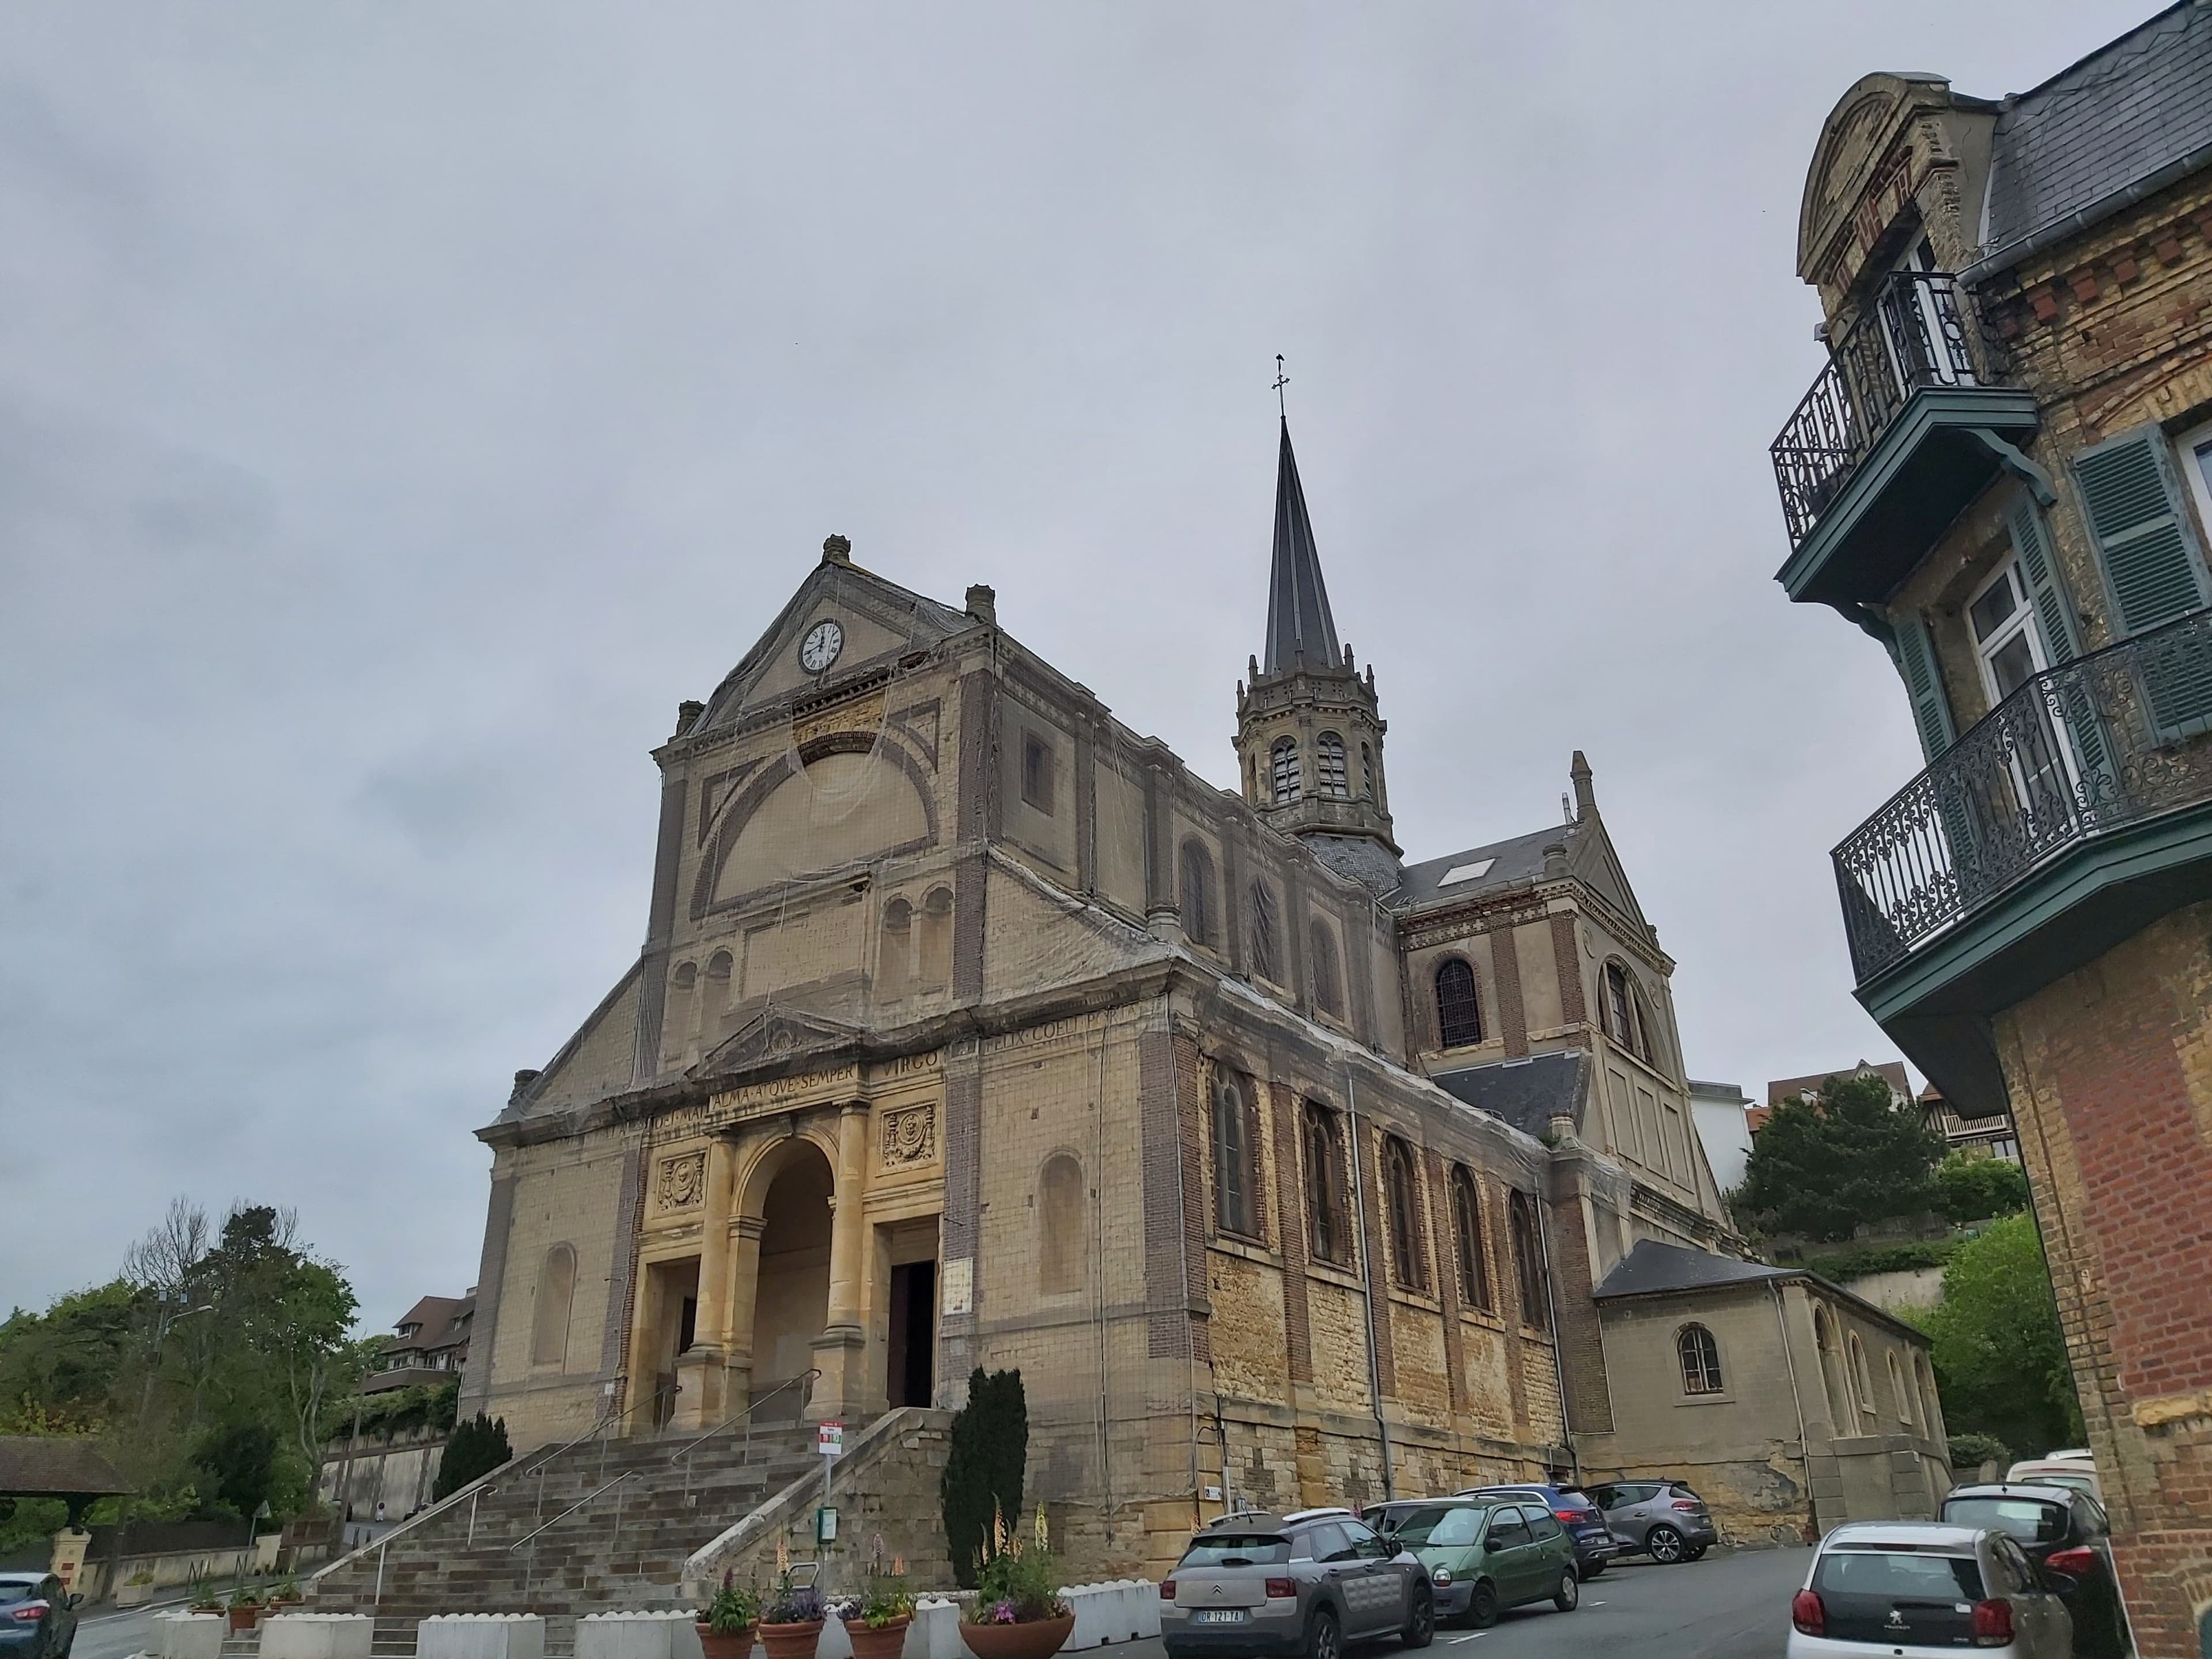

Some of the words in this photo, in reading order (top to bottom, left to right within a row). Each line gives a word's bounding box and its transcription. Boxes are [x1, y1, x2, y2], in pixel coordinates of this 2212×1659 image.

[713, 1089, 749, 1110] ALMA
[756, 1077, 798, 1098] ATQVE
[801, 1067, 854, 1089] SEMPER
[884, 1050, 937, 1077] VIRGO
